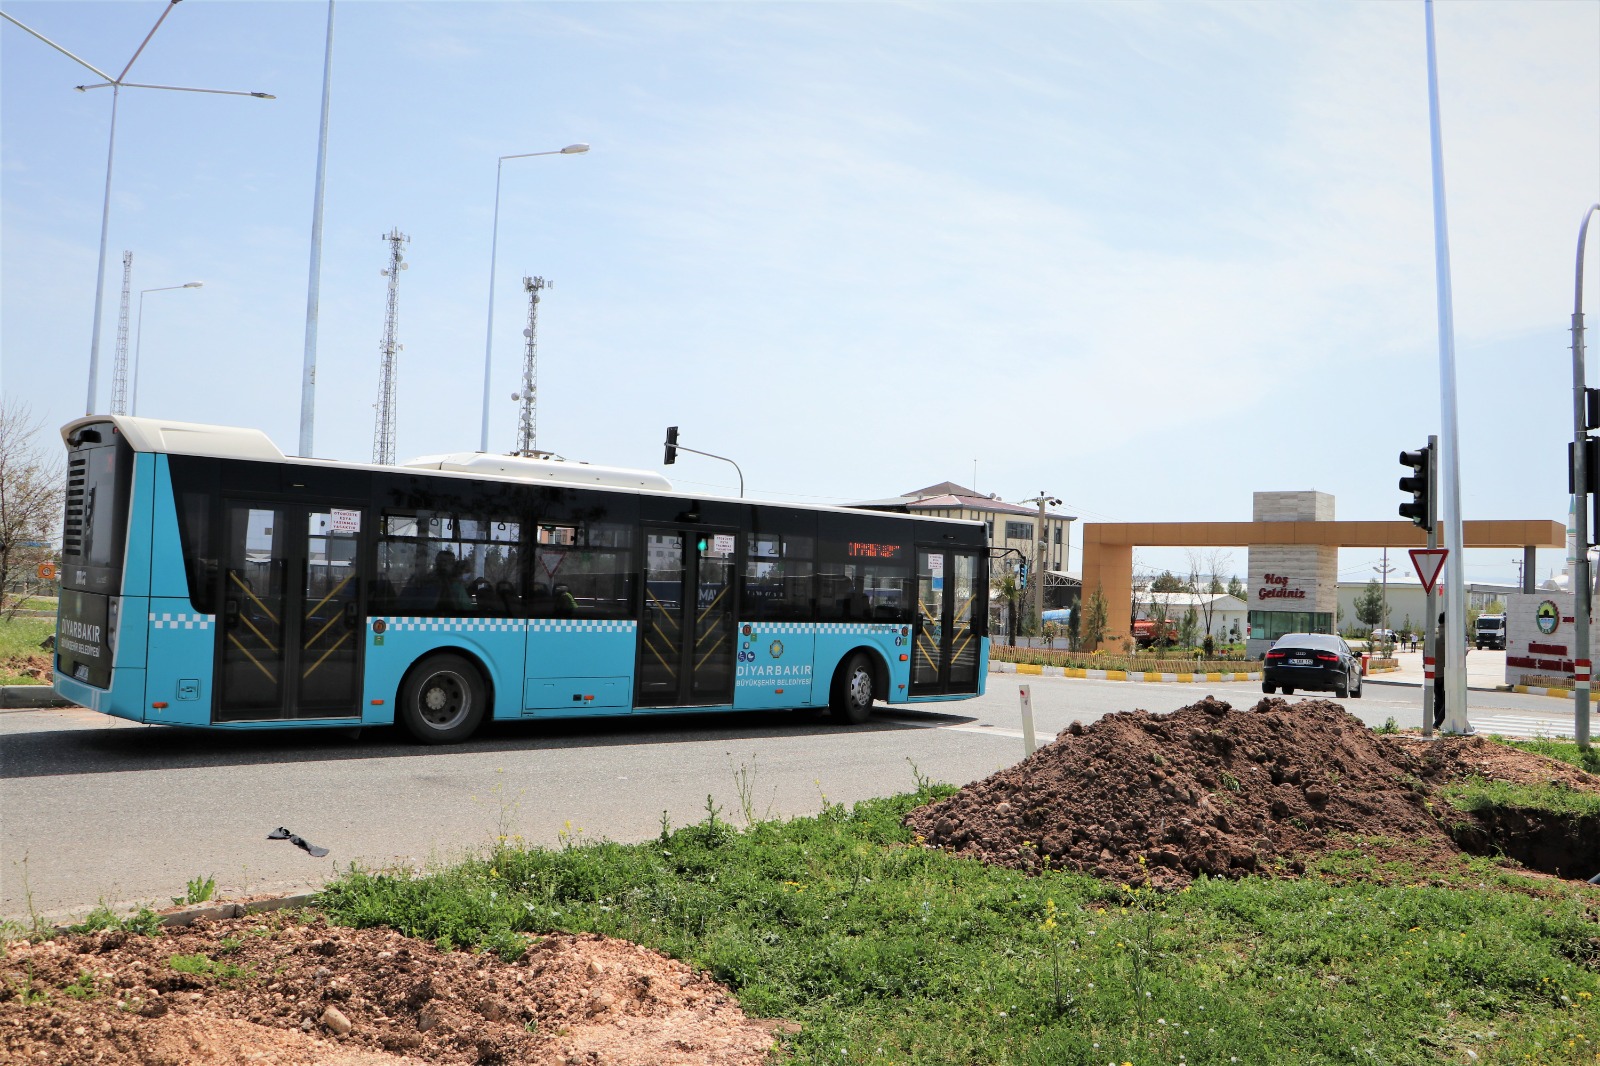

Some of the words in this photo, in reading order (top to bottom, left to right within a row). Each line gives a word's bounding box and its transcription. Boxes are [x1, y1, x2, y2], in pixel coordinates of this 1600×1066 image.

[1264, 573, 1289, 587] Hoş
[1259, 587, 1306, 600] Geldiniz
[61, 616, 100, 643] DİYARBAKIR
[737, 663, 812, 676] DİYARBAKIR
[736, 679, 775, 687] BÜYÜKŞEHİR
[777, 677, 812, 686] BELEDİYESİ
